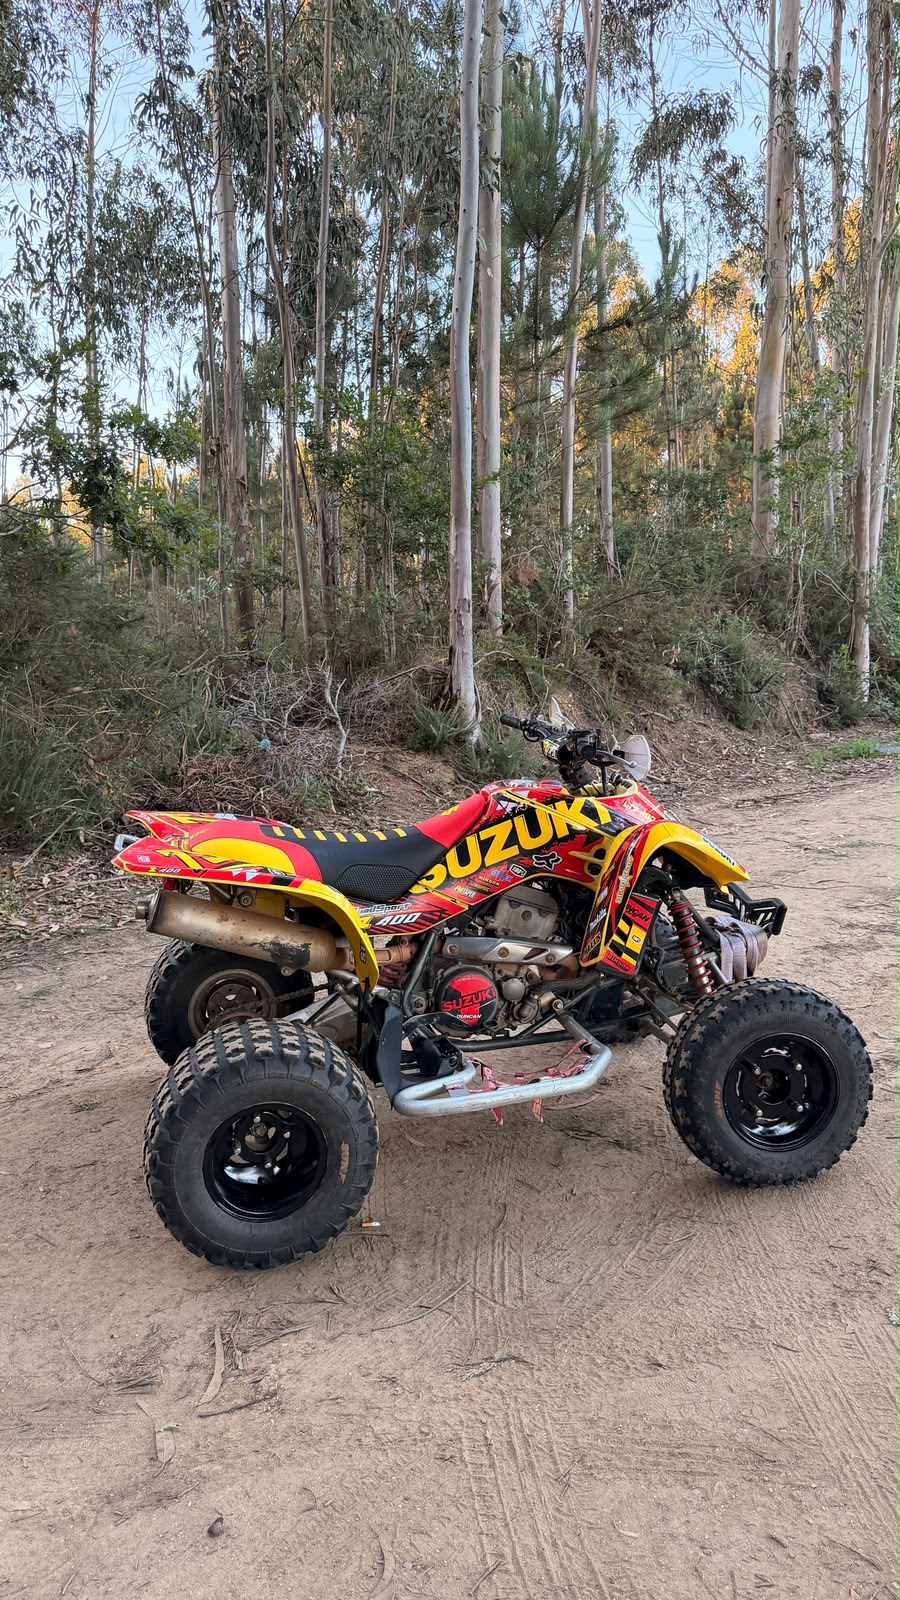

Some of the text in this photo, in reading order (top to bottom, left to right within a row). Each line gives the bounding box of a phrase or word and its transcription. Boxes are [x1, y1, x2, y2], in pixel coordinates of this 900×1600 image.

[356, 903, 412, 915] uadSport
[374, 911, 422, 927] 400
[443, 988, 496, 1013] SUZUKI
